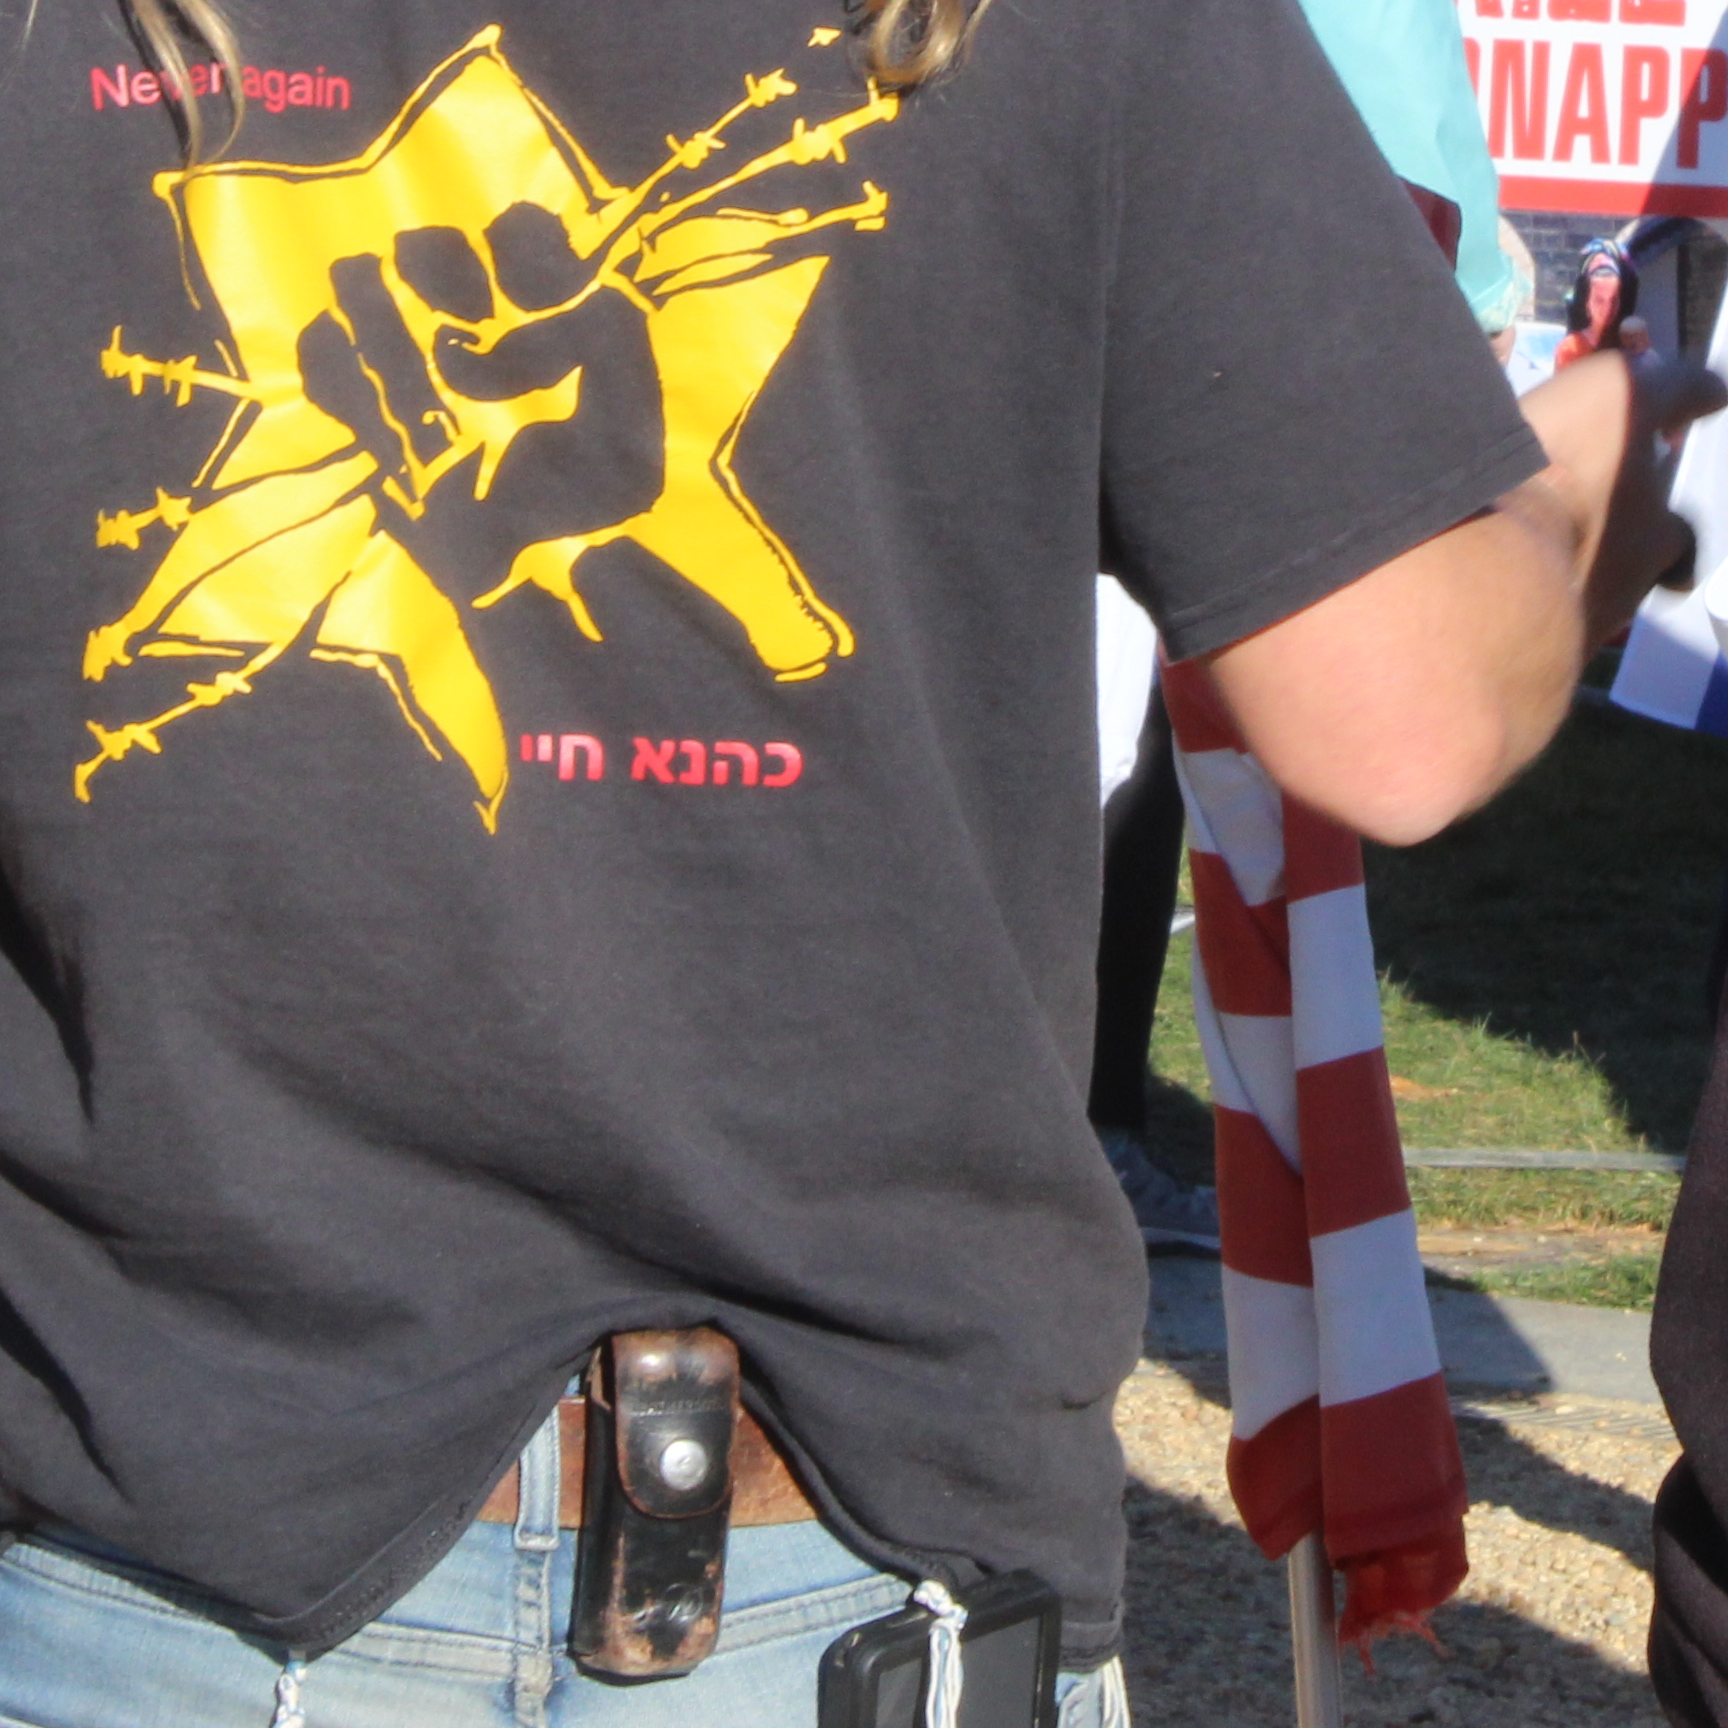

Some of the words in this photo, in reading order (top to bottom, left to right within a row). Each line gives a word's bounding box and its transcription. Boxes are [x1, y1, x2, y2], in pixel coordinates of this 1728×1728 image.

[239, 65, 352, 114] again
[519, 733, 606, 782] חיי
[629, 735, 805, 789] כהנא
